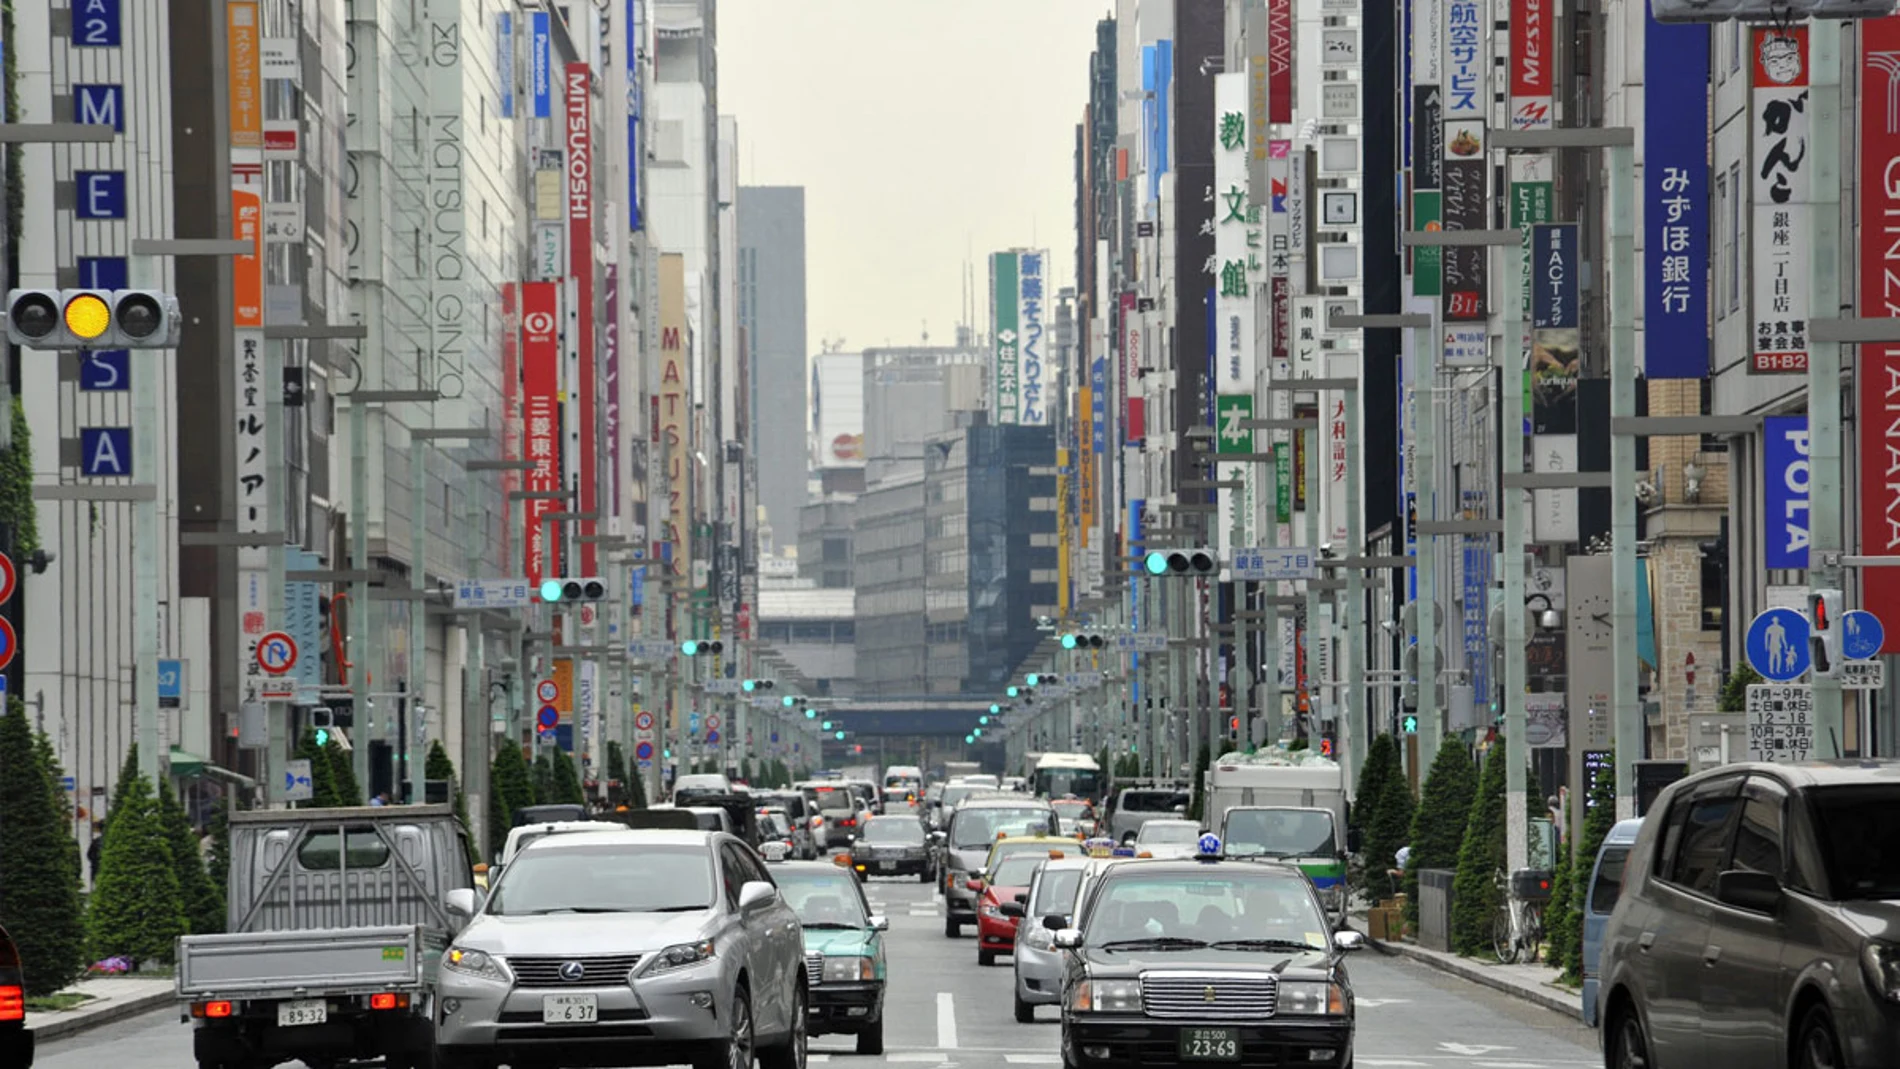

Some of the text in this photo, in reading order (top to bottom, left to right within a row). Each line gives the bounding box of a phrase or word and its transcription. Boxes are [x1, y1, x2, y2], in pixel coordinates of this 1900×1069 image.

[536, 33, 548, 96] Panasonic
[1450, 2, 1478, 110] 航空サービス
[569, 72, 587, 218] MITSUKOSHI
[1761, 90, 1809, 204] がんこ
[1218, 111, 1248, 297] 教文館
[1535, 187, 1547, 224] 資格取
[1661, 167, 1691, 313] みずほ銀行
[1773, 212, 1790, 313] 銀座一丁目店
[1021, 253, 1042, 422] 新築そっくりさん
[1129, 329, 1140, 378] docomo
[1300, 306, 1314, 380] 南風ビル
[1758, 321, 1805, 336] お食事
[999, 345, 1016, 423] 住友不動産
[238, 338, 265, 549] 喫茶室ルノアー
[1221, 403, 1250, 446] 本
[531, 395, 552, 574] 三菱東京UF銀行
[1785, 429, 1809, 554] POLA
[459, 585, 526, 599] 銀座一丁目
[1235, 555, 1309, 570] 銀座一丁目
[289, 1008, 325, 1023] 89-32
[1193, 1041, 1236, 1057] 23-69
[1211, 1030, 1227, 1040] 500
